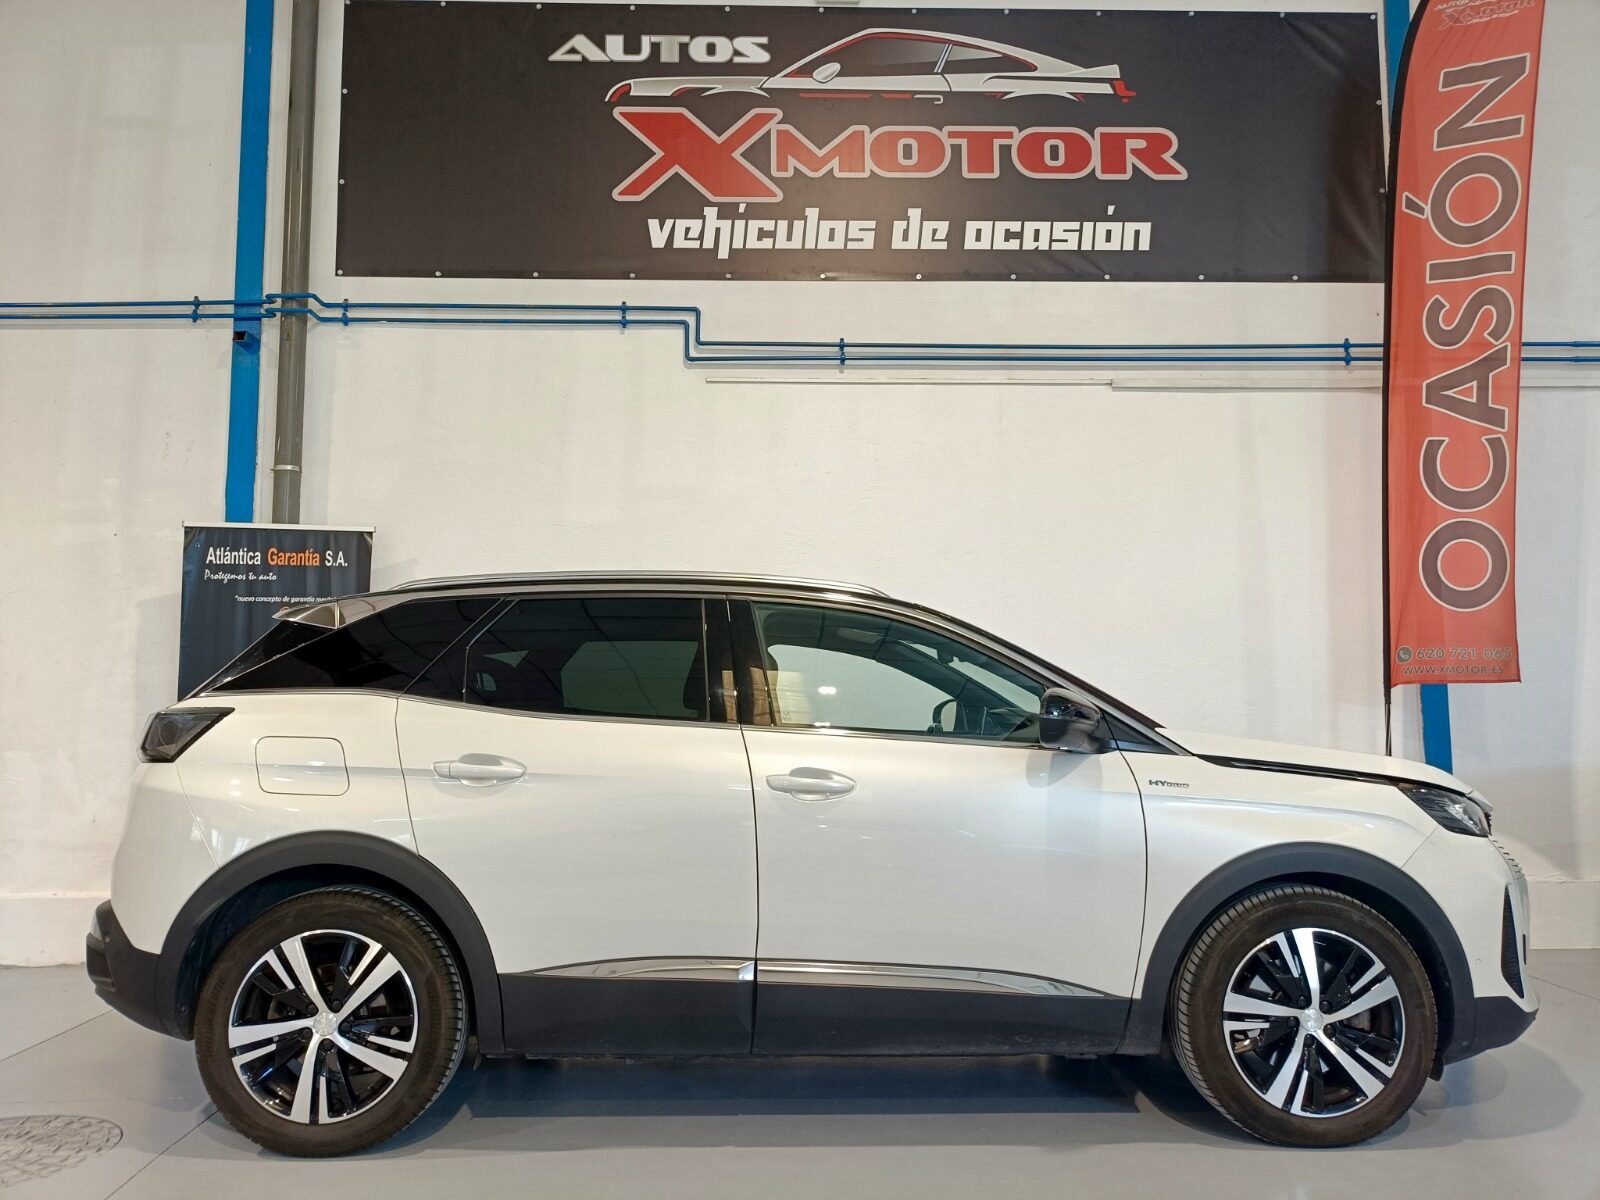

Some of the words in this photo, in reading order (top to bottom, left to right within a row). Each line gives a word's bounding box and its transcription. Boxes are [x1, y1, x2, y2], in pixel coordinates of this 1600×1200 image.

[547, 35, 772, 64] AUTOS
[612, 107, 1188, 203] XMOTOR
[647, 203, 876, 259] vehículos
[891, 207, 948, 252] de
[963, 205, 1152, 252] ocasión
[1401, 52, 1531, 613] OCASIÓN
[205, 546, 261, 565] Atlántica
[267, 546, 321, 567] Garantía
[324, 550, 348, 567] S.A.
[204, 569, 246, 583] Protegemos
[258, 572, 277, 580] auto
[1416, 647, 1445, 660] 620
[1450, 647, 1477, 660] 721
